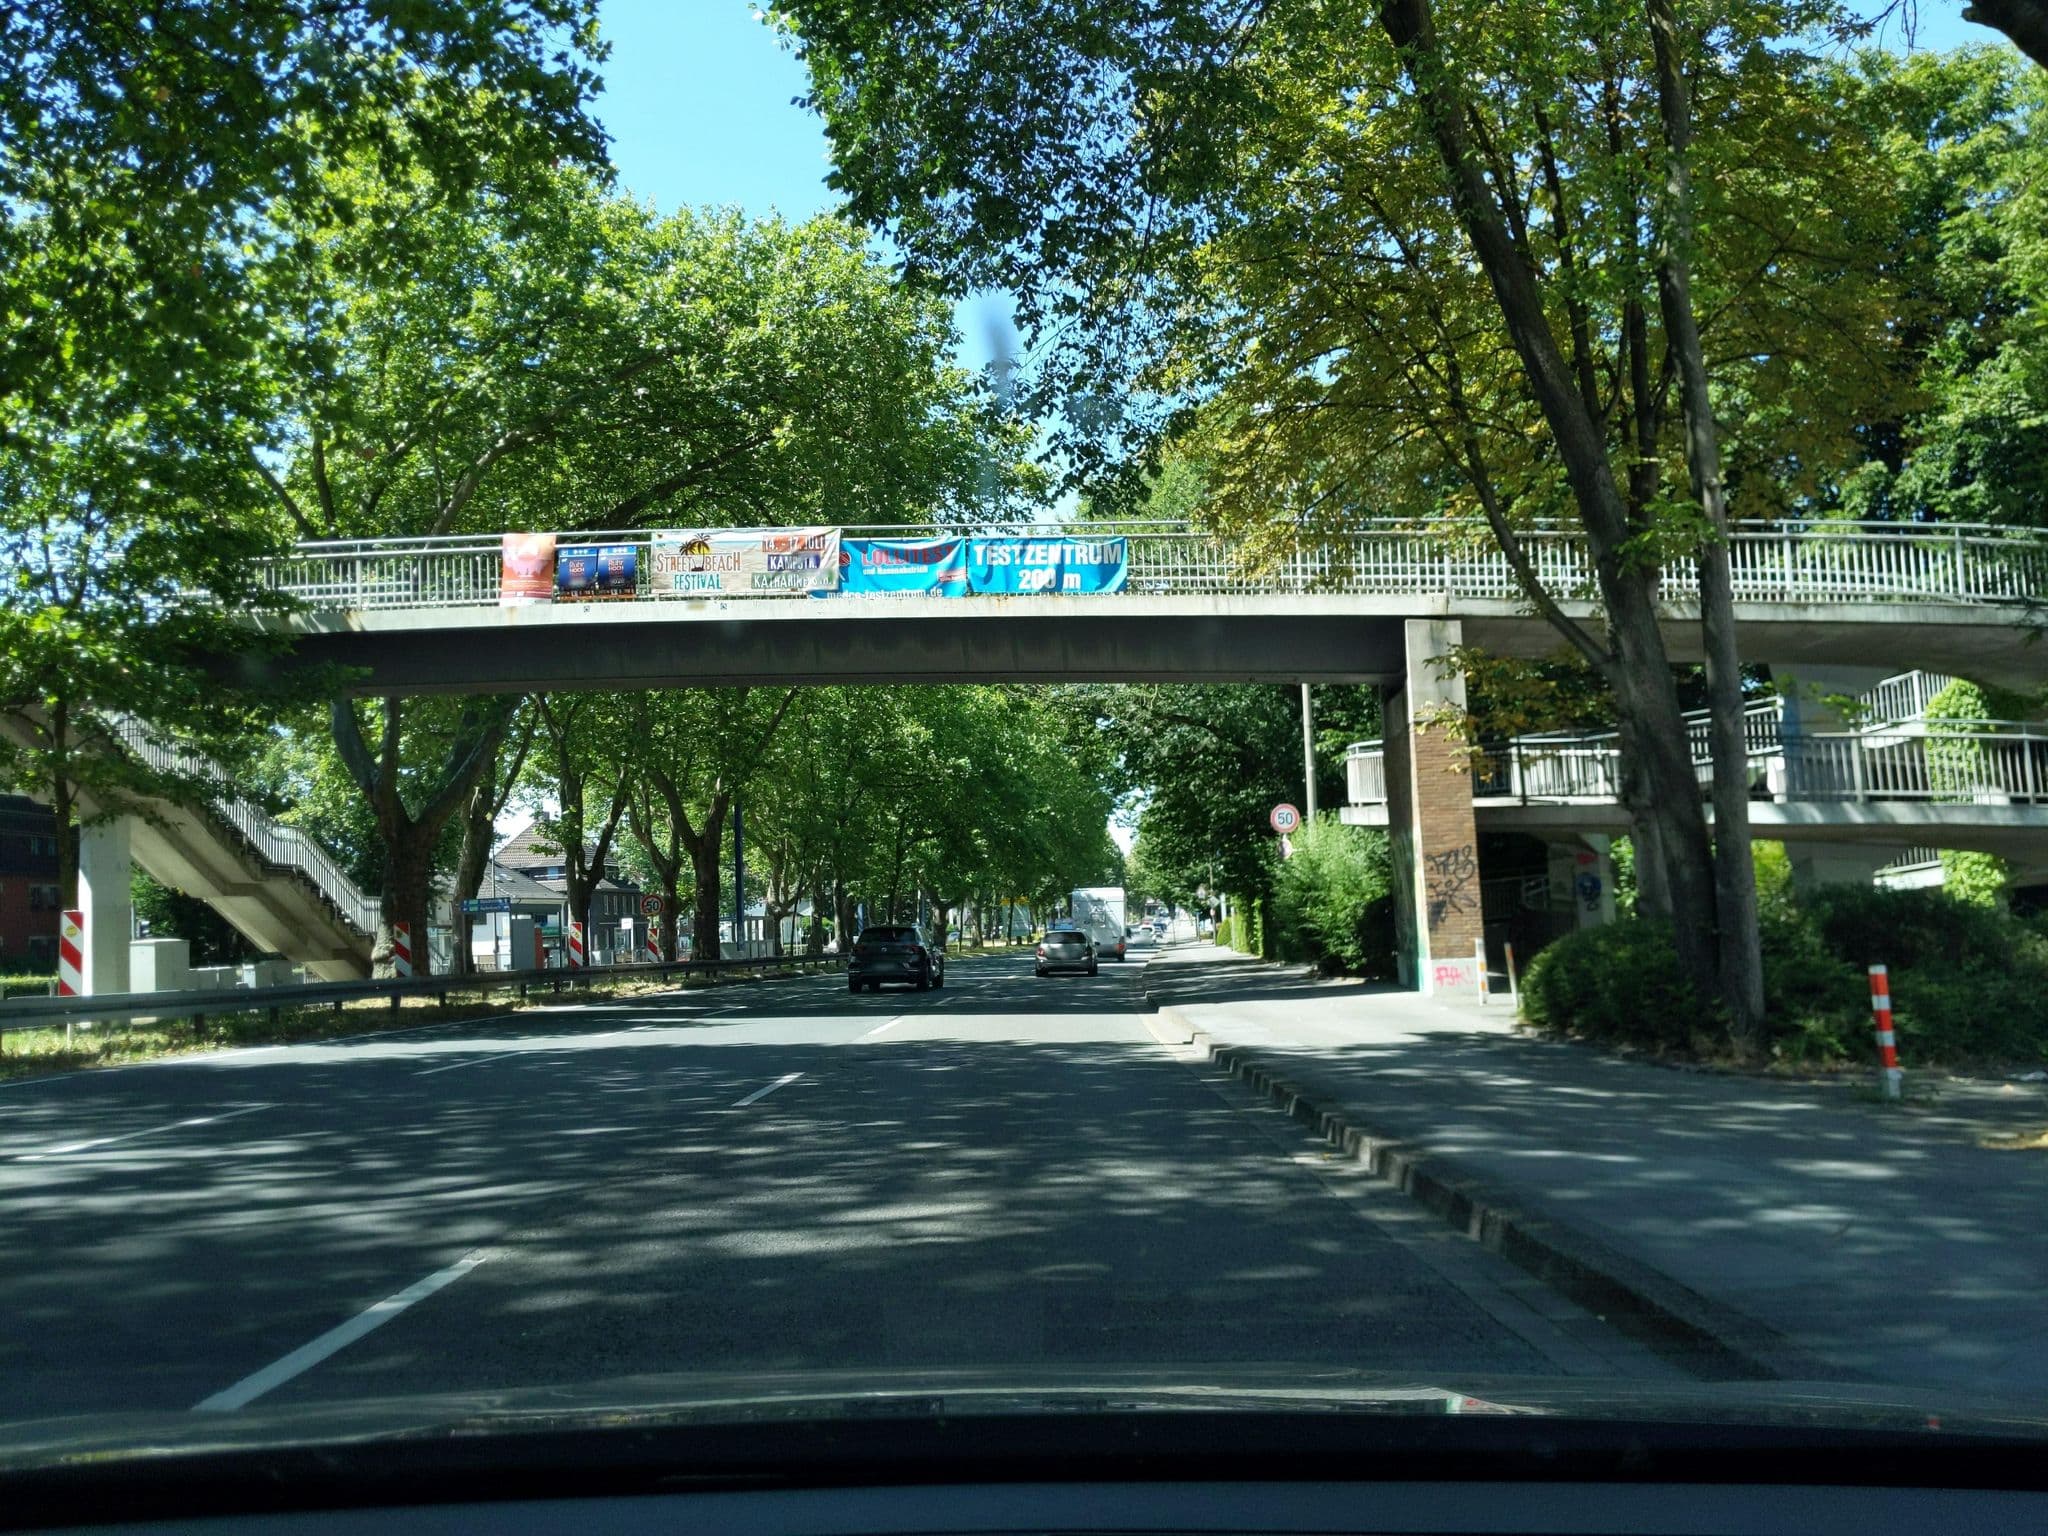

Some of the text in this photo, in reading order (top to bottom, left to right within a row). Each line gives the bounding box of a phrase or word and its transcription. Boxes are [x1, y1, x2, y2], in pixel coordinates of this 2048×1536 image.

[764, 536, 779, 550] 14.
[788, 536, 802, 550] 17.
[804, 535, 826, 550] JULI
[656, 551, 741, 572] STREET BEACH
[974, 543, 1122, 566] TESTZENTRUM
[674, 573, 723, 590] FESTIVAL
[1019, 567, 1082, 590] 200 m
[1278, 812, 1293, 825] 50
[646, 900, 660, 912] 50
